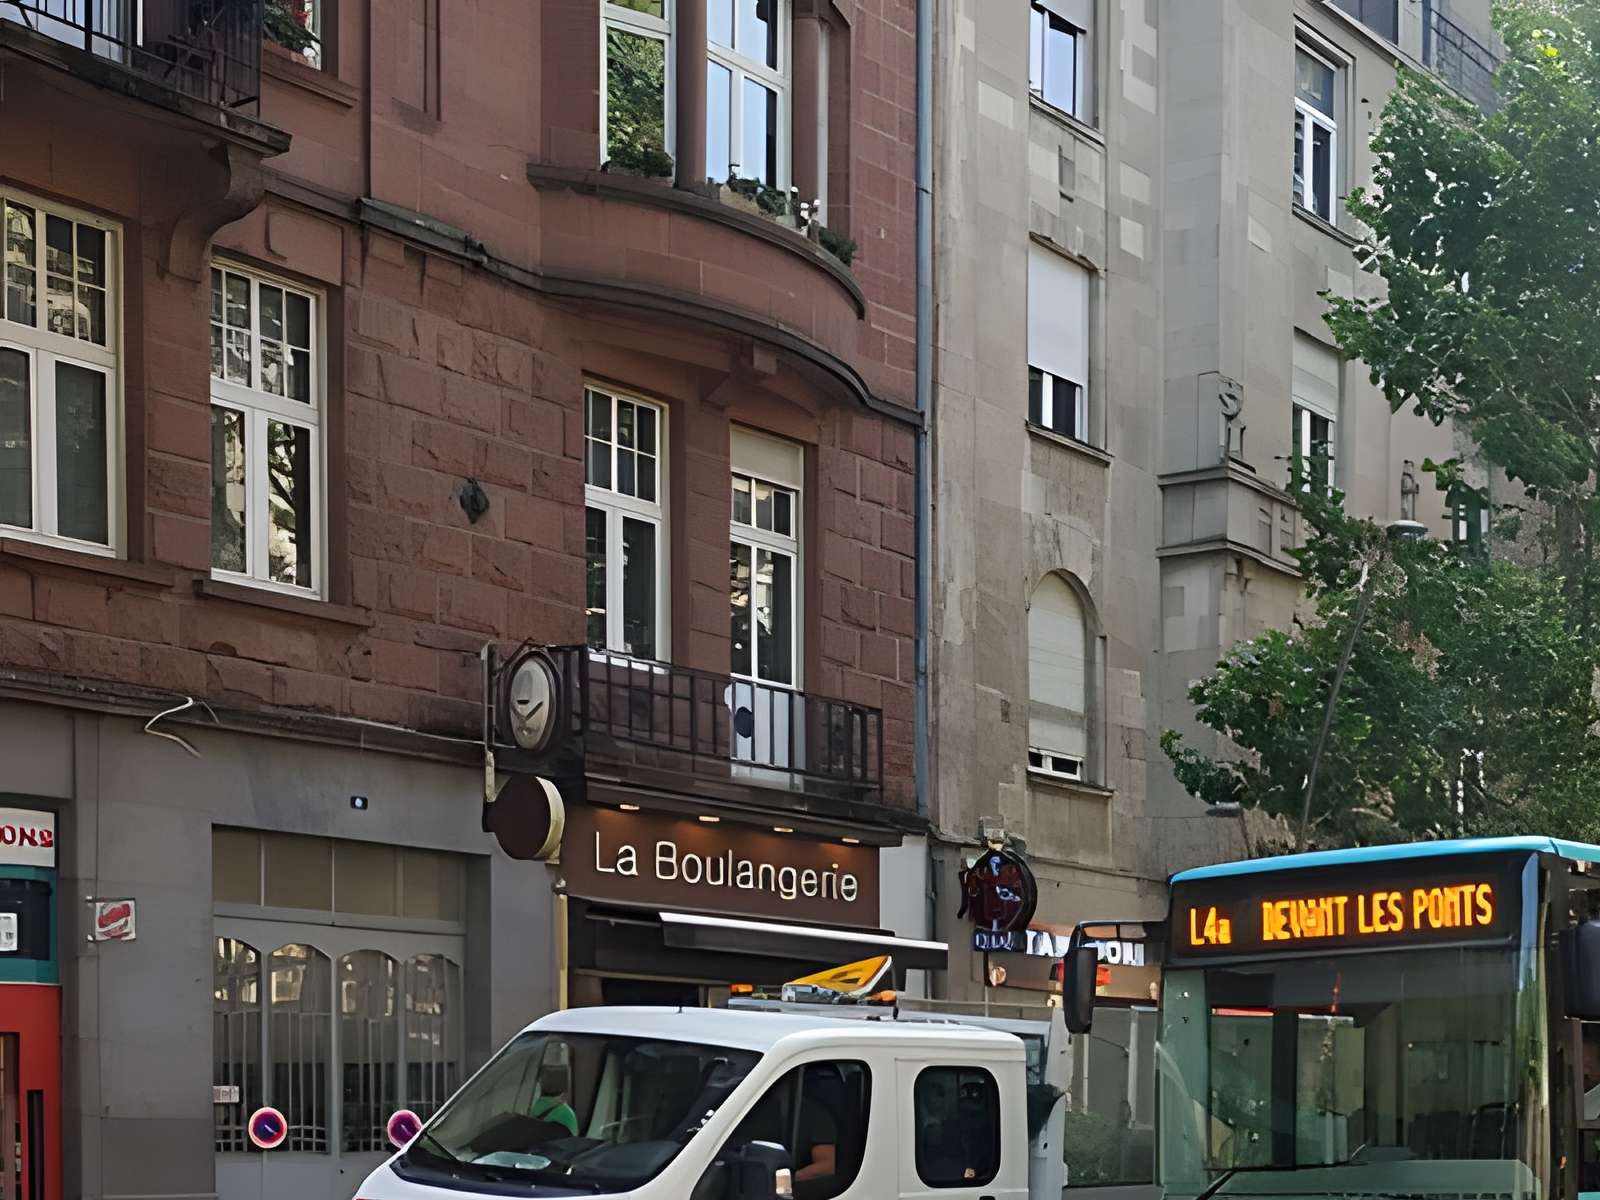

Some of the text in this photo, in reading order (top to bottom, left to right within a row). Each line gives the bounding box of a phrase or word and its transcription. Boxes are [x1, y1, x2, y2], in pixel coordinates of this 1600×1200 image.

[595, 831, 858, 902] La Boulangerie
[1357, 891, 1404, 934] LES
[1412, 883, 1493, 930] PONTS
